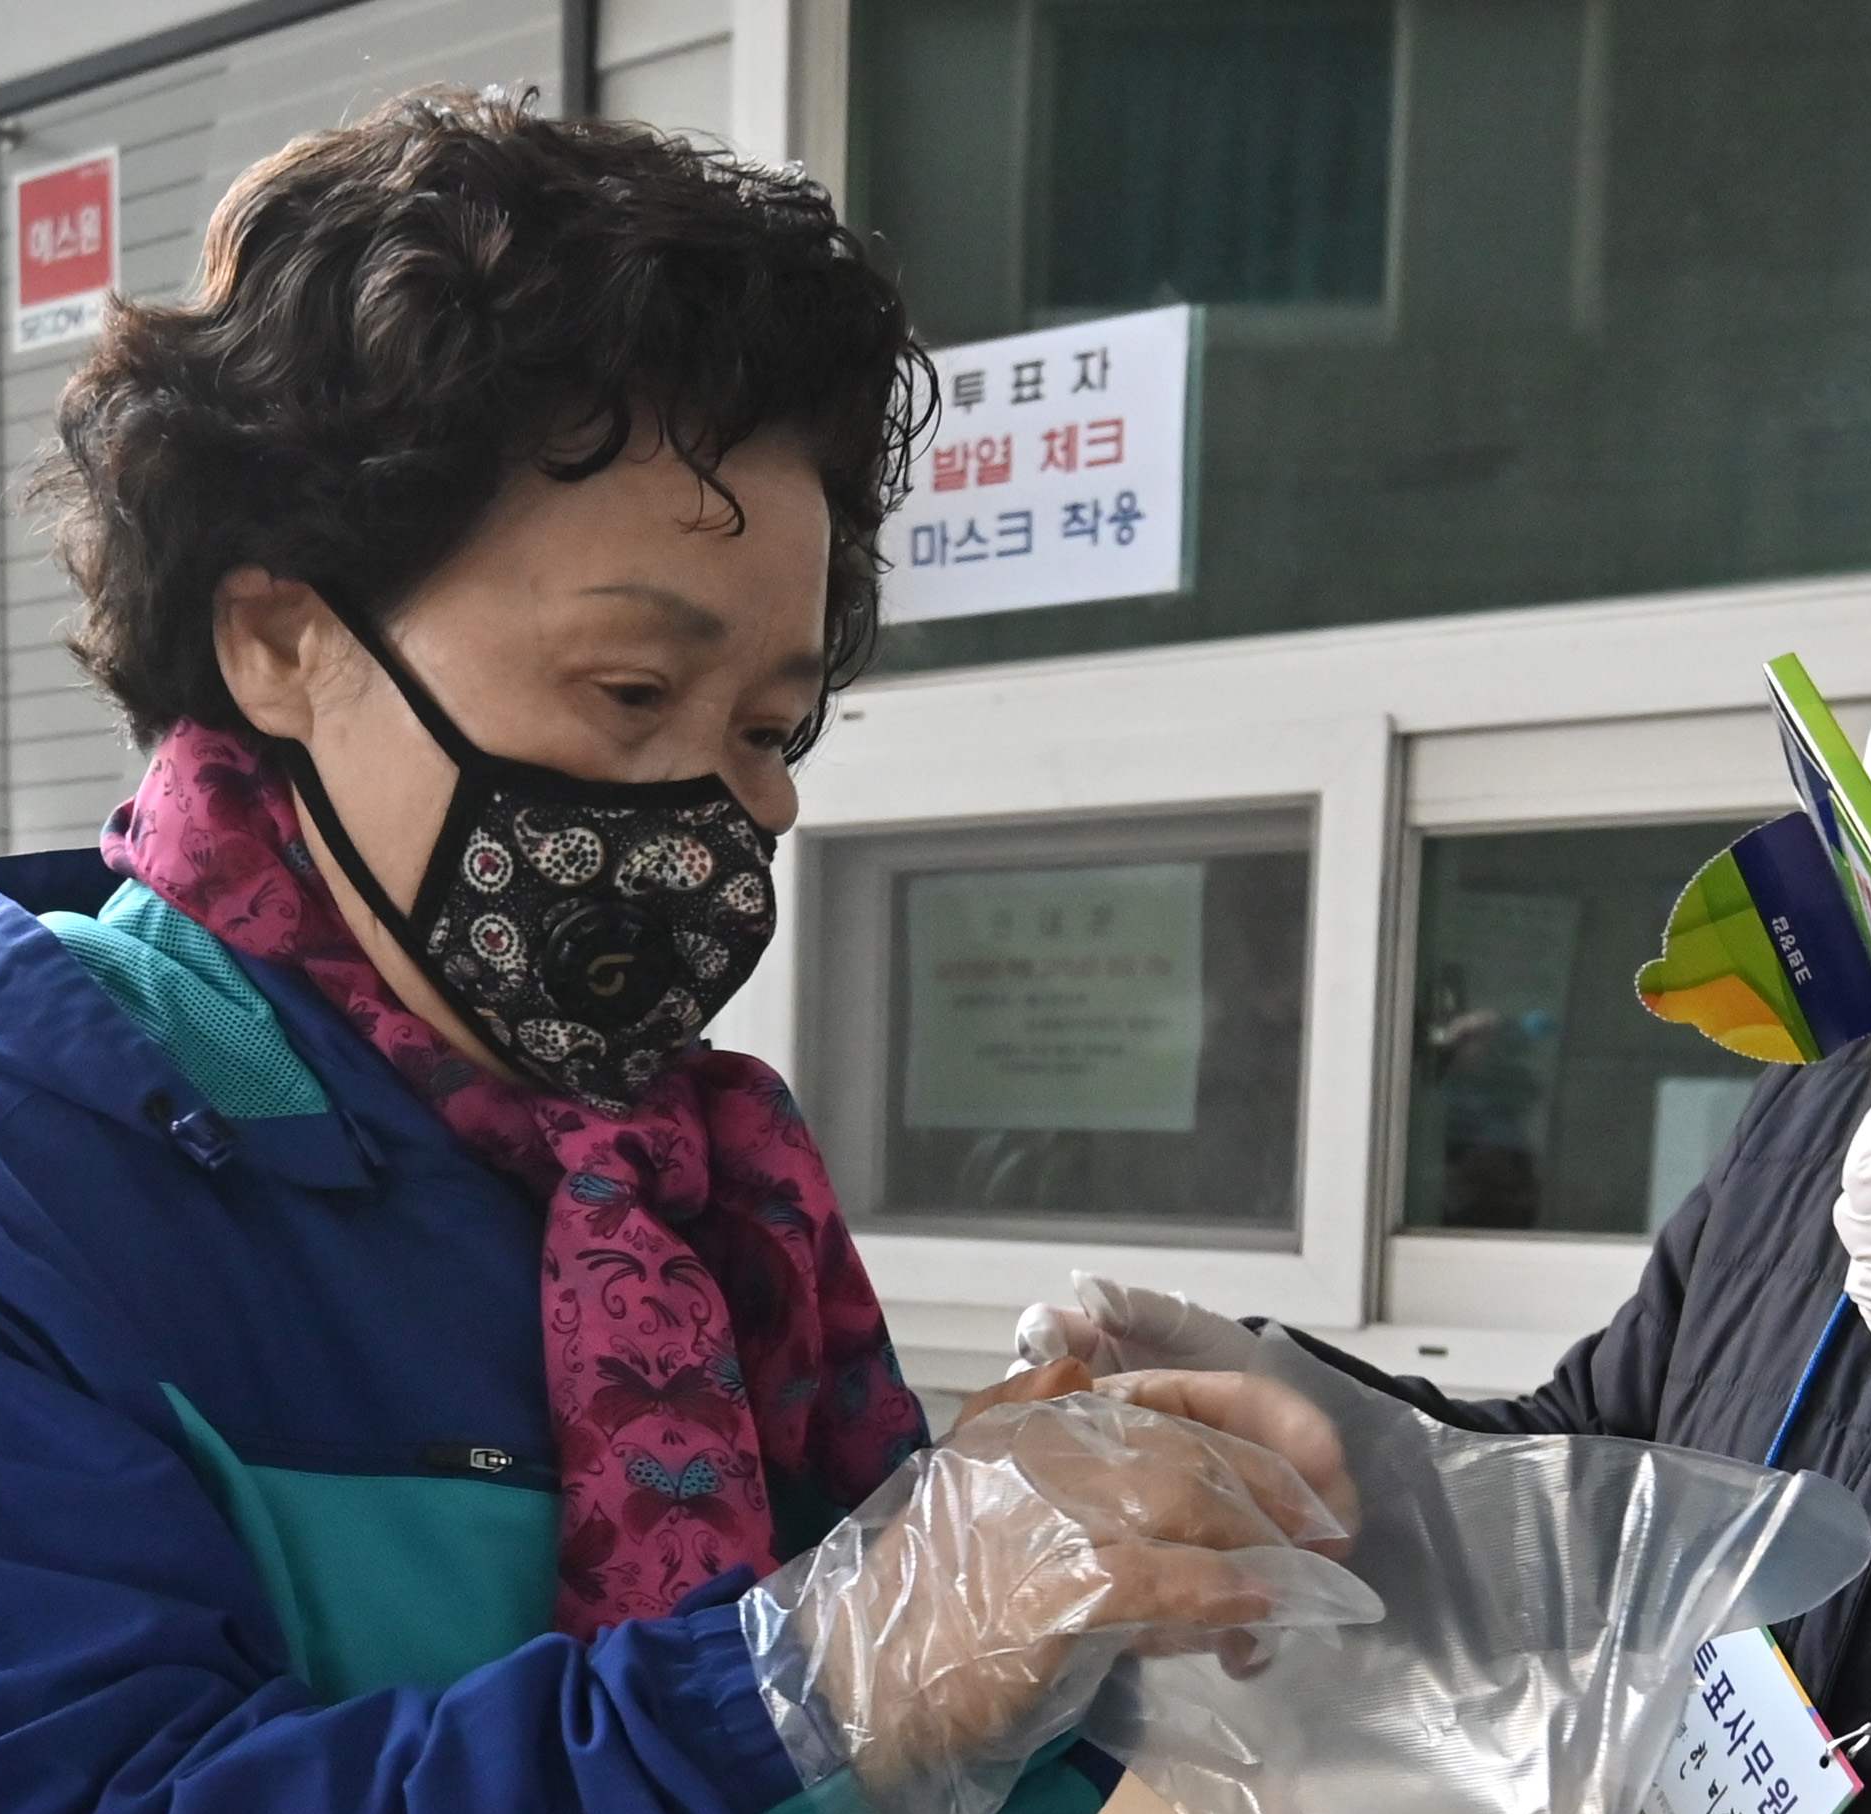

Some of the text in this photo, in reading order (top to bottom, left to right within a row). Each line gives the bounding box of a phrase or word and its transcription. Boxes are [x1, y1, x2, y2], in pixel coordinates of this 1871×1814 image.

[931, 416, 1125, 494] 발열 체크
[911, 489, 1146, 569] 마스크 착용
